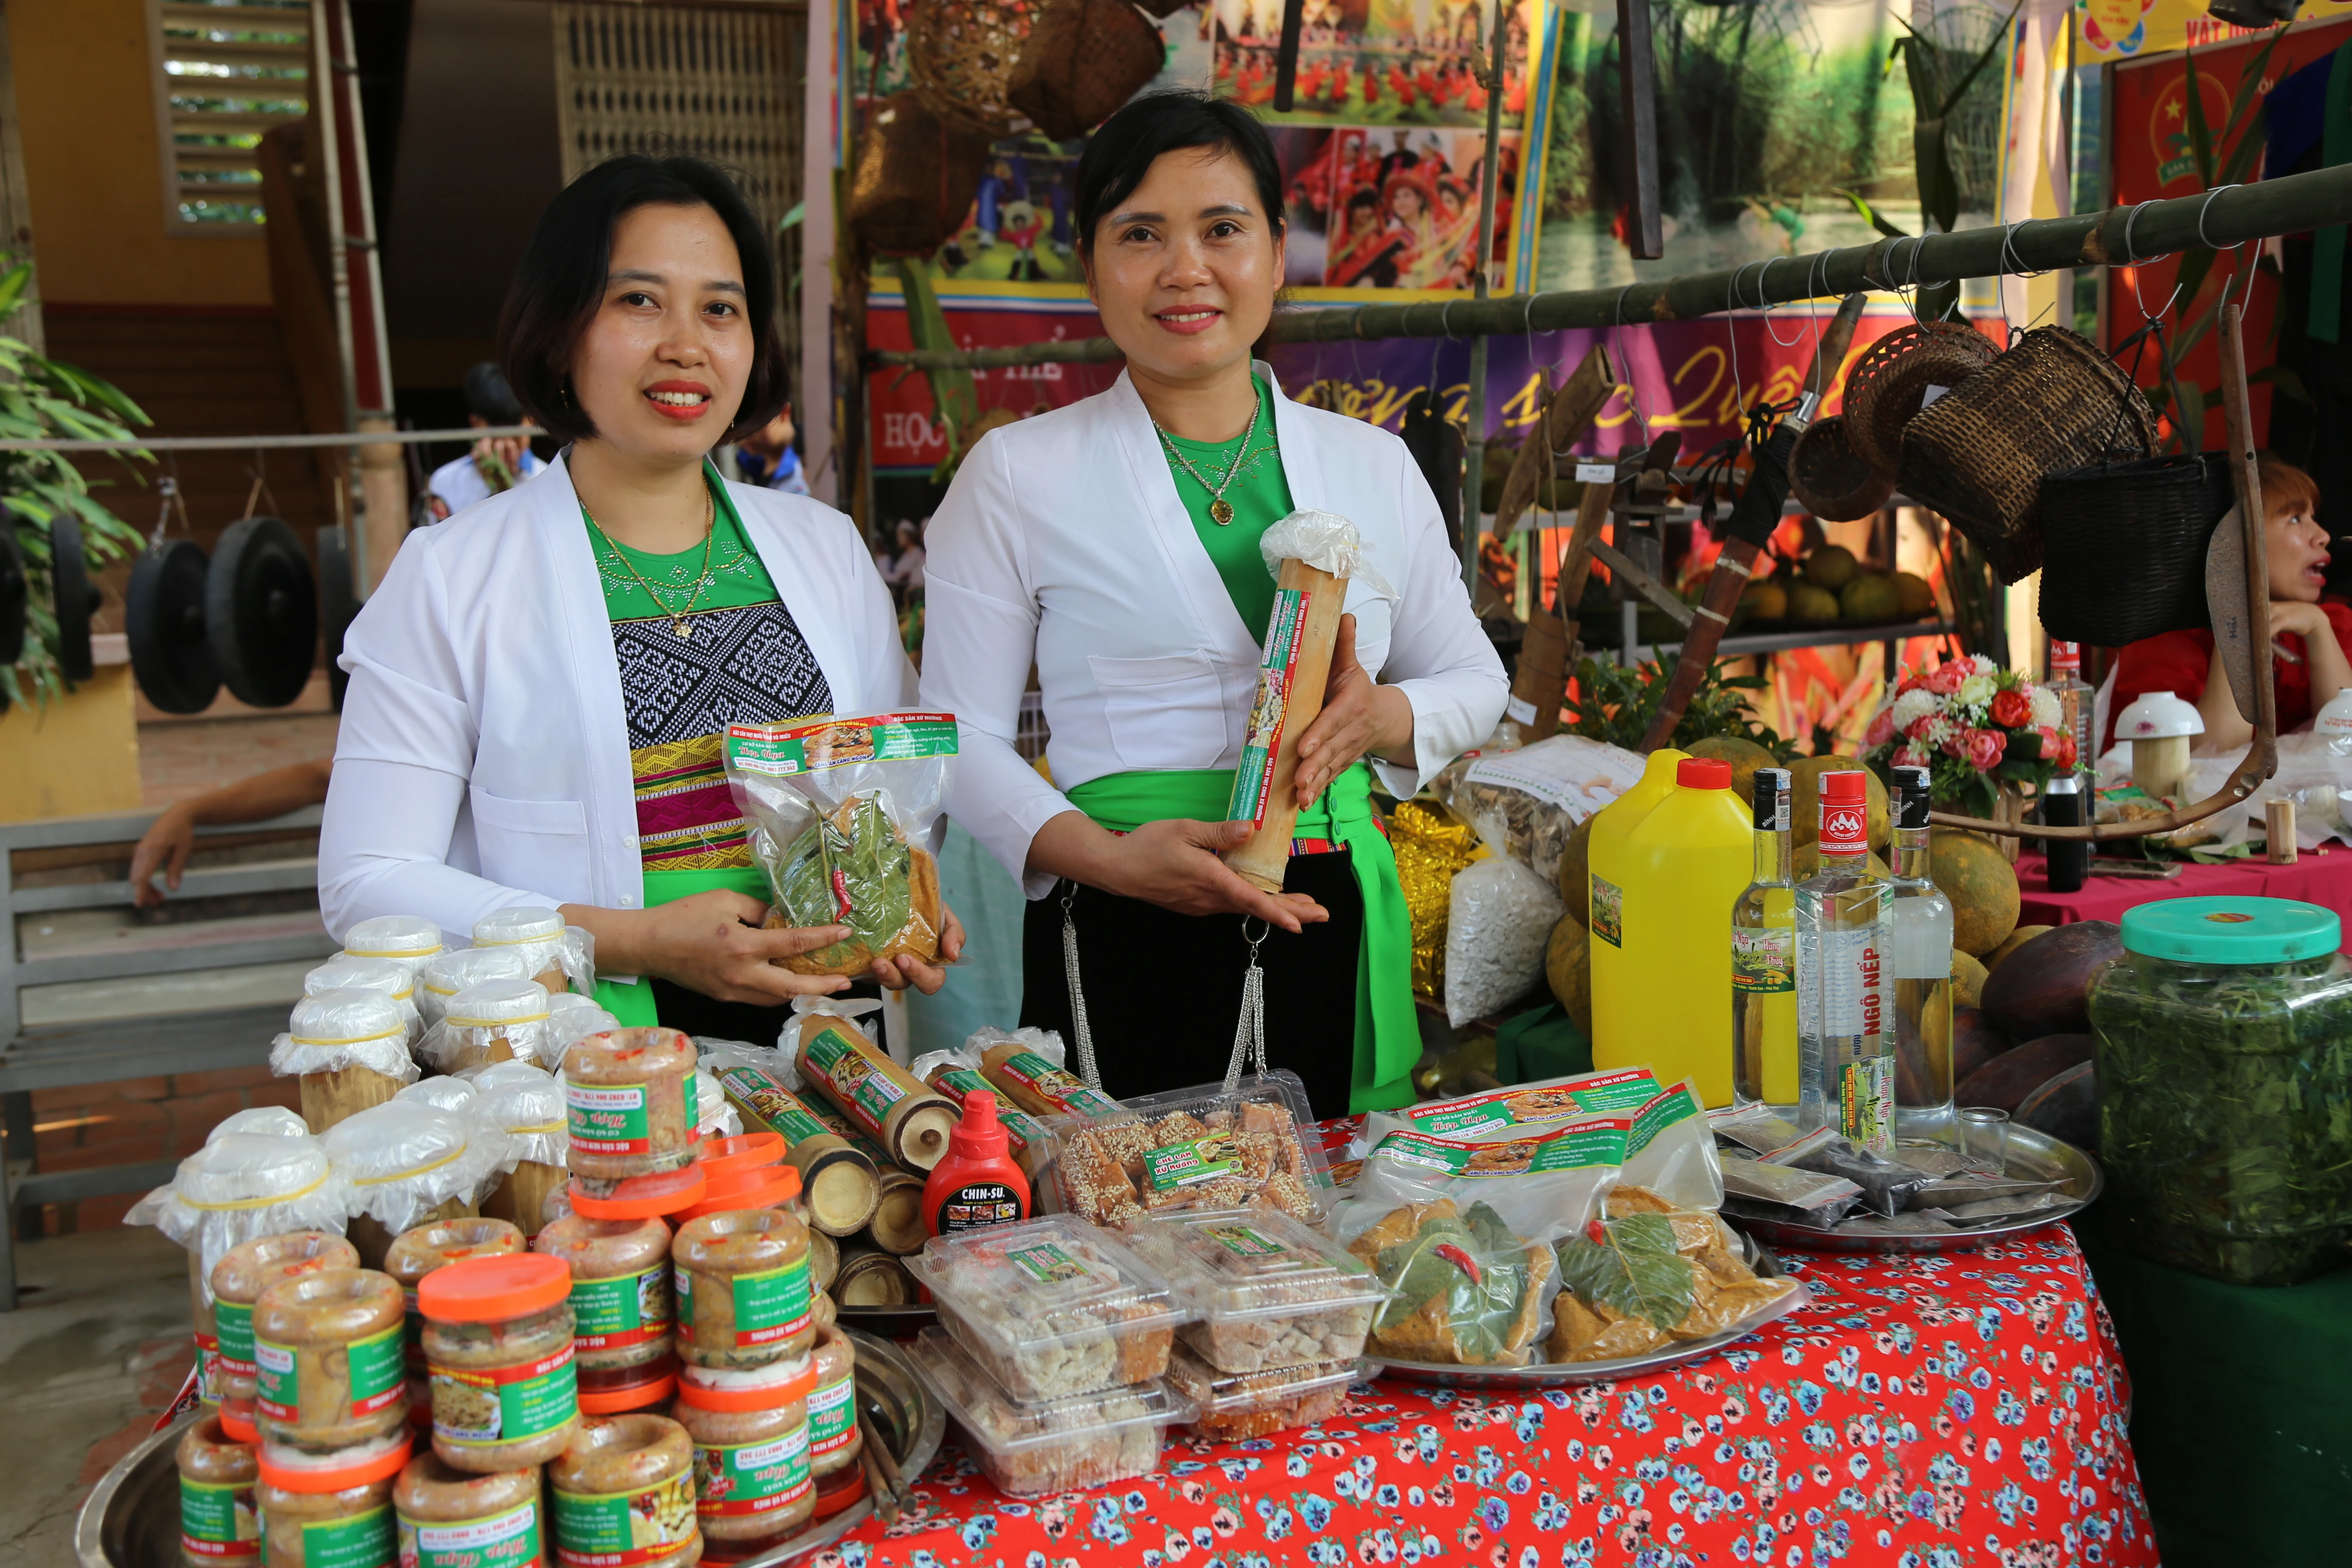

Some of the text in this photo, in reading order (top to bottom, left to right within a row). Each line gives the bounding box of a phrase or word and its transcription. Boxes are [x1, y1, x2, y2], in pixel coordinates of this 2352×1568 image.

[1291, 608, 1296, 617] CƠ
[1289, 617, 1294, 625] SỞ
[760, 749, 786, 760] Nga
[837, 756, 850, 764] CÀNG
[1256, 805, 1264, 821] MƯỜNG
[1762, 815, 1776, 828] BÌNH
[1737, 929, 1749, 948] Ngô
[1763, 939, 1781, 953] Hùng
[1856, 947, 1880, 989] NẾP
[1859, 993, 1881, 1036] NGÔ
[1853, 1034, 1862, 1056] RƯỢU
[1620, 1073, 1640, 1082] MƯỜNG
[1879, 1076, 1892, 1099] Rượu
[1430, 1113, 1490, 1132] Hợp Nga
[1156, 1155, 1174, 1166] CHÈ
[1154, 1164, 1168, 1175] XỨ
[962, 1187, 1004, 1200] CHIN-SU
